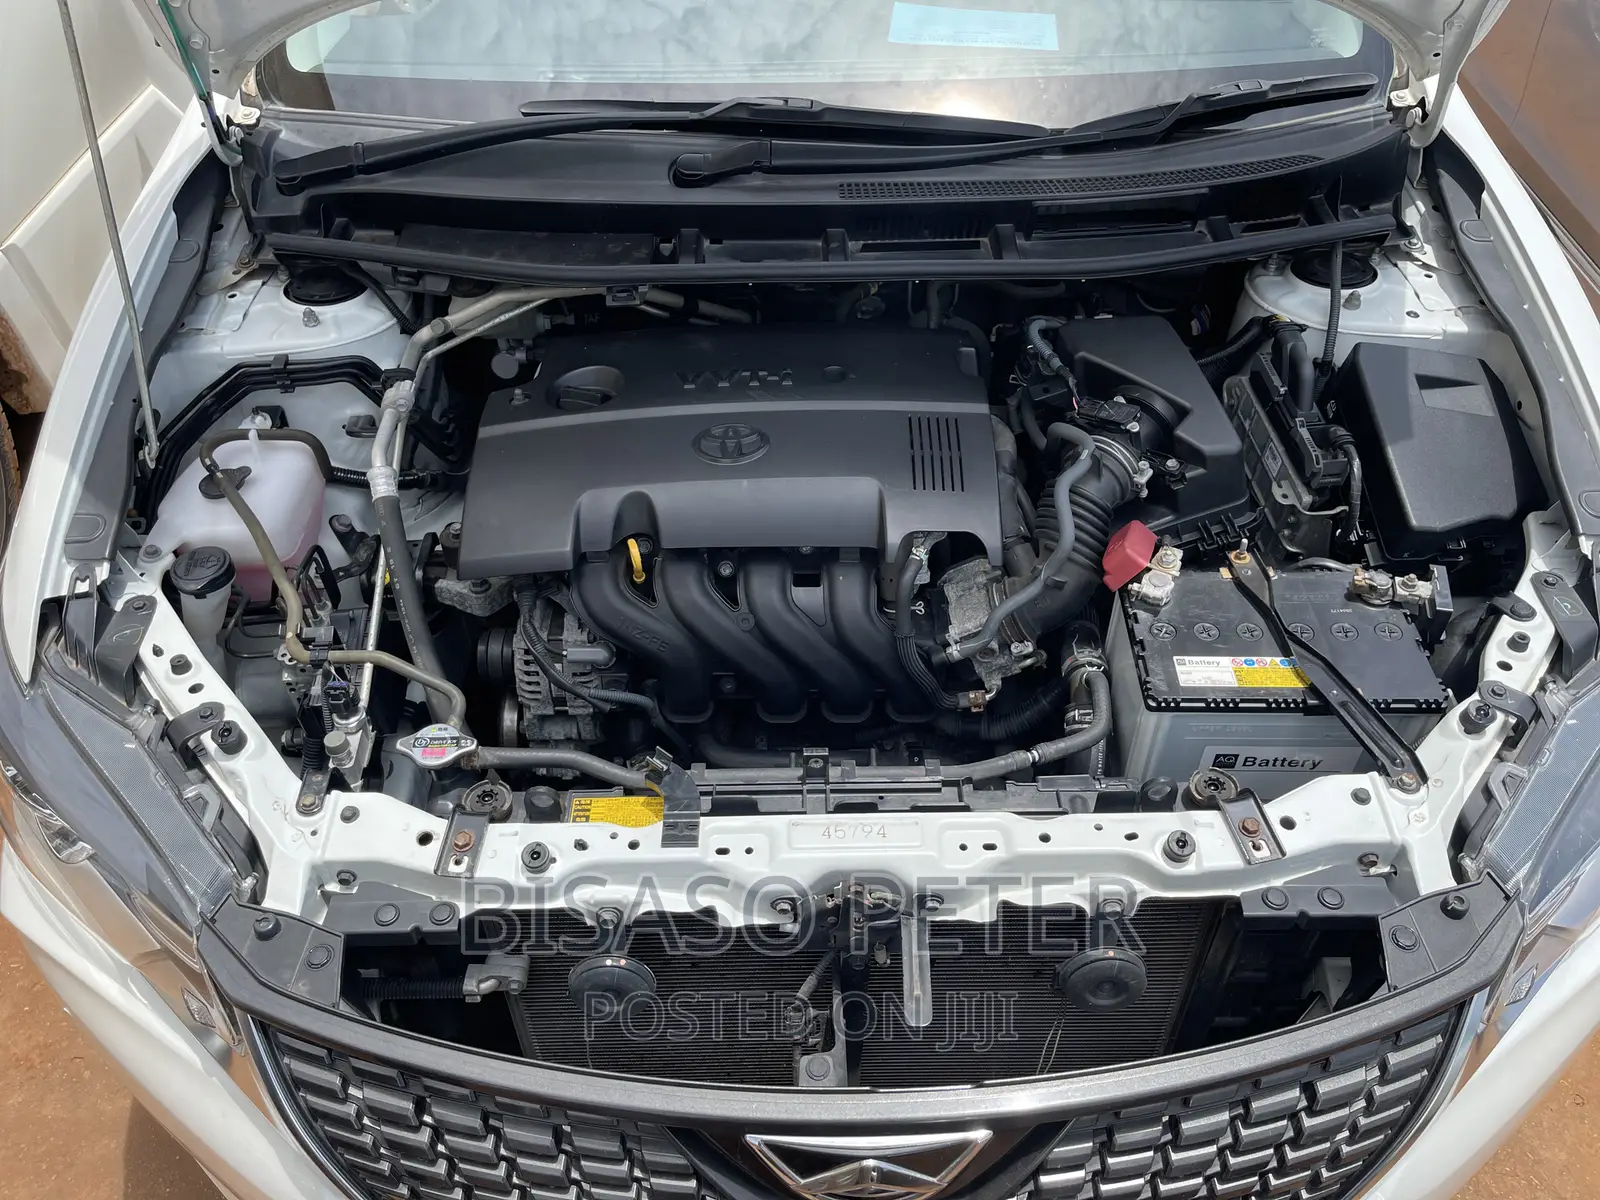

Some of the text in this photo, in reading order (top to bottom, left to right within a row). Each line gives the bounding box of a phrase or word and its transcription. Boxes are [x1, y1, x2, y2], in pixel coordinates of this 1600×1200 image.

[1187, 659, 1221, 667] Battery
[1241, 756, 1323, 771] Battery
[821, 824, 888, 840] 45794
